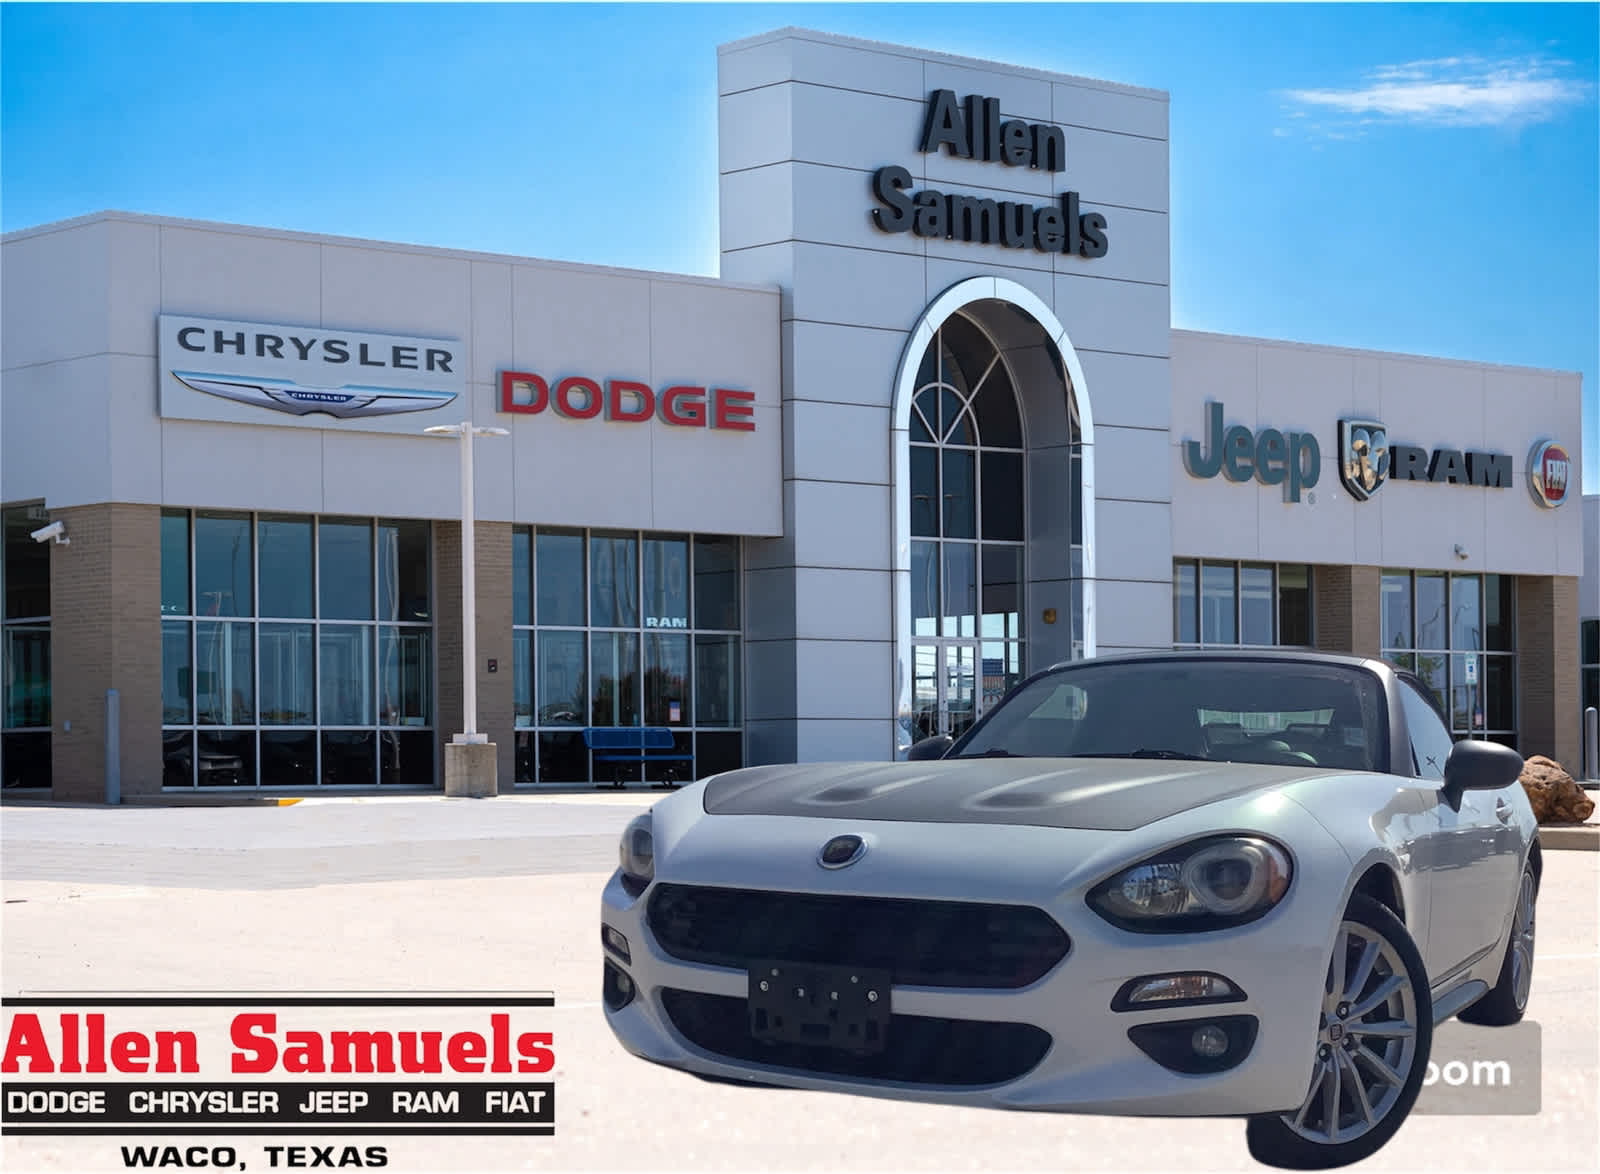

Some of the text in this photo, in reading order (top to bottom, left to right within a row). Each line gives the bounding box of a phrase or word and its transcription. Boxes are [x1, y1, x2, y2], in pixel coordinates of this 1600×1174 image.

[920, 88, 1066, 172] Allen
[871, 165, 1109, 258] Samuels
[177, 326, 454, 373] CHRYSLER
[290, 391, 347, 402] CHRYSLER
[496, 370, 756, 432] DODGE
[1183, 400, 1321, 503] Jeep
[1388, 444, 1514, 489] RAM
[645, 617, 688, 629] RAM
